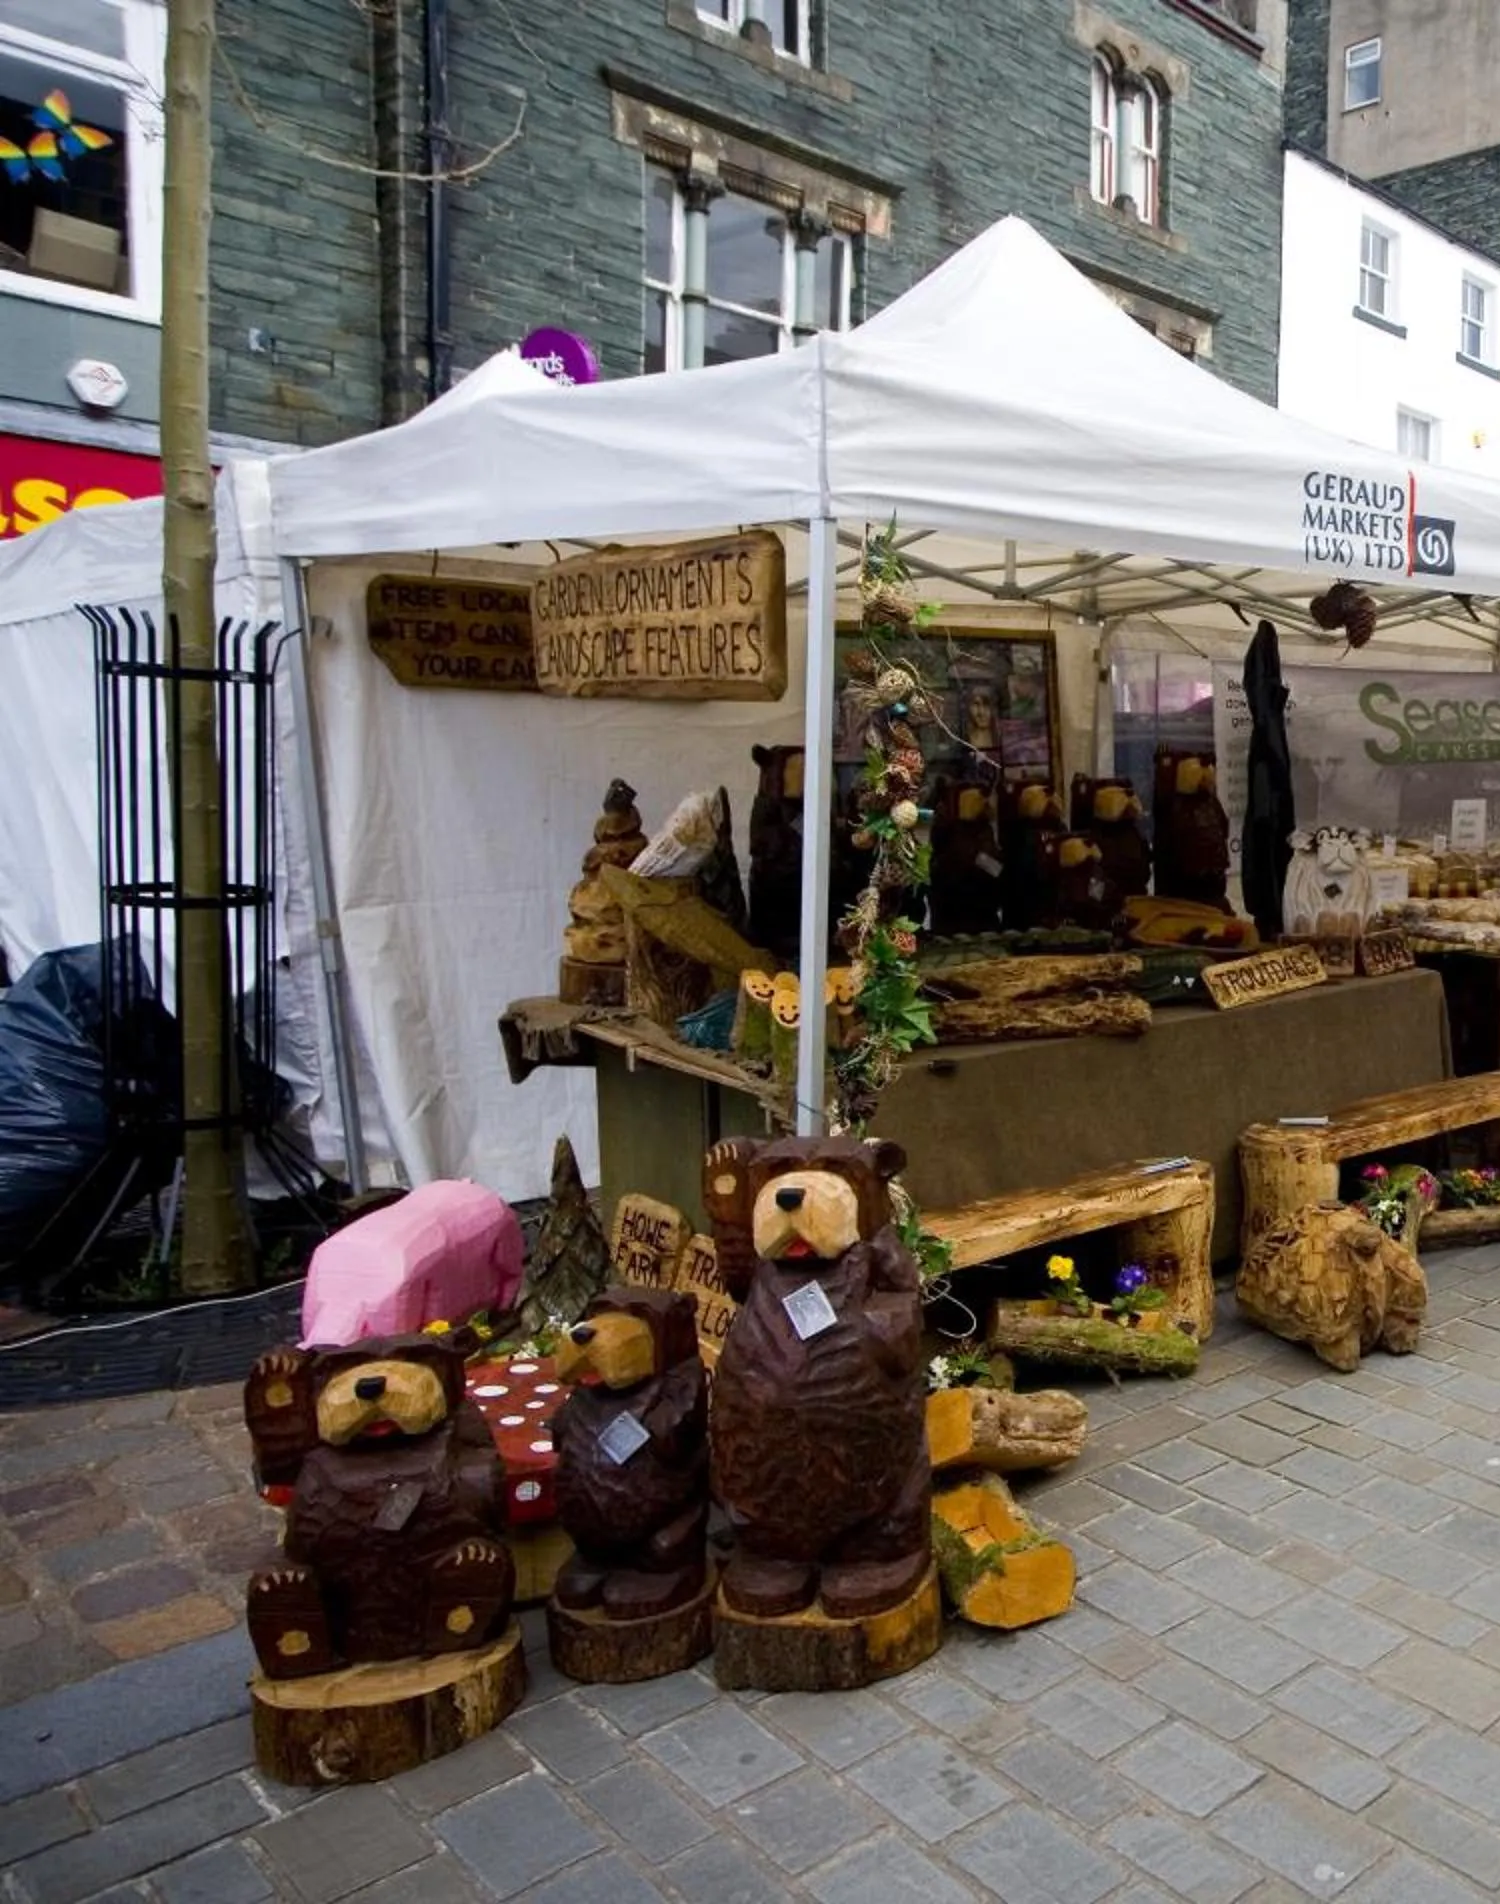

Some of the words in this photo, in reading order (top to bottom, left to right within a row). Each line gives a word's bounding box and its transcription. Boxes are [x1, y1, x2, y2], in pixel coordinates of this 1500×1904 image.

[1303, 471, 1405, 513] GERAUD
[1302, 503, 1404, 542] MARKETS
[1365, 543, 1405, 570] LTD
[380, 583, 448, 609] FREE
[536, 572, 605, 622] GARDEN
[614, 551, 753, 615] ORNAMENTS
[413, 651, 481, 679] YOUR
[538, 626, 638, 678] LANDSCAPE
[645, 620, 763, 678] FEATURES
[1416, 742, 1491, 762] CAKES
[1213, 950, 1319, 996] TROUTDALE
